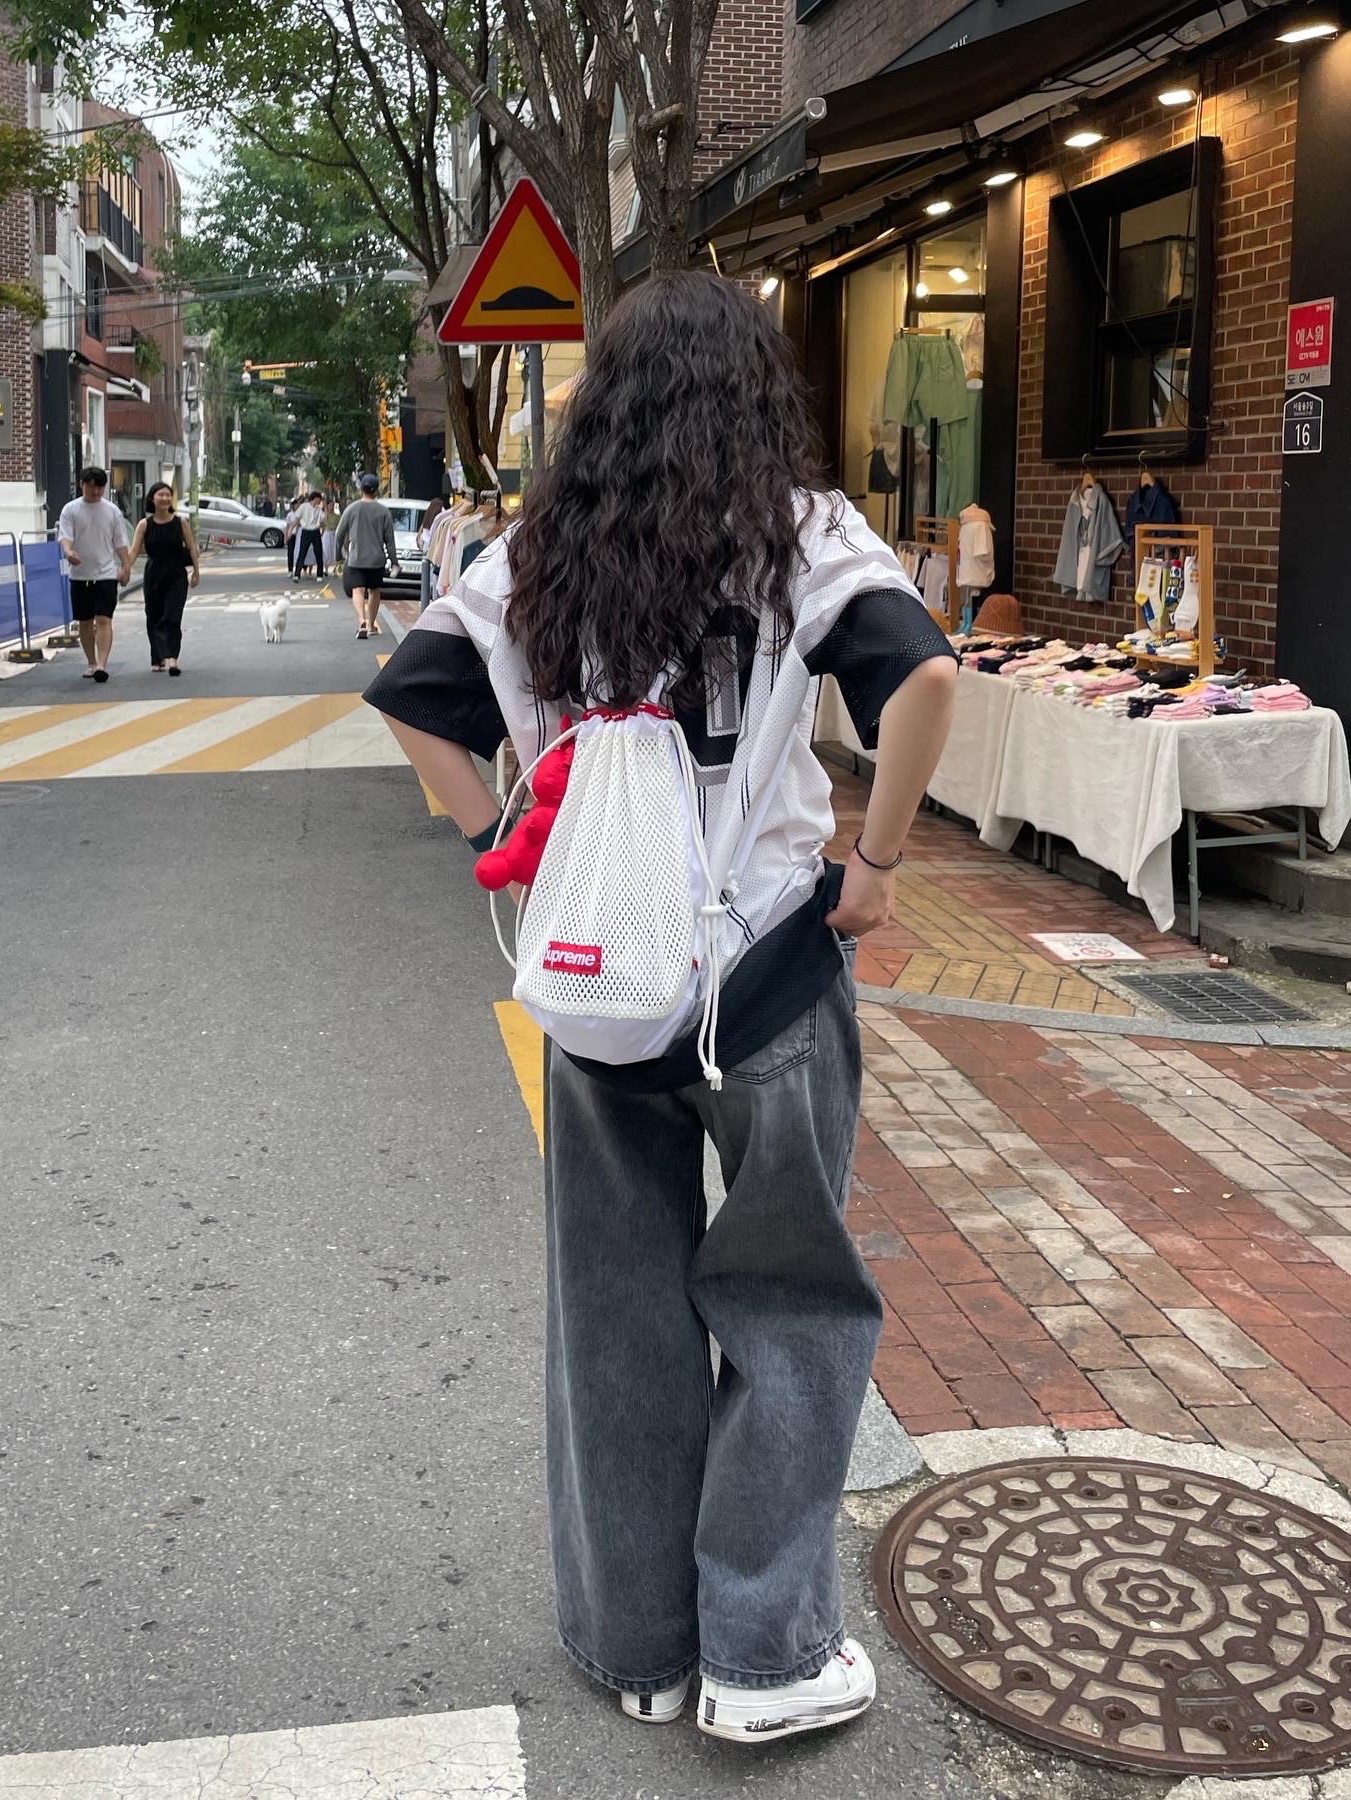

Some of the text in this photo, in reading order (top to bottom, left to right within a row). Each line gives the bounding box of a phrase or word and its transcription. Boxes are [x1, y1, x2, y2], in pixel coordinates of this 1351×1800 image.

[1295, 324, 1324, 348] 에스원
[1295, 423, 1310, 447] 16
[544, 948, 597, 967] upreme
